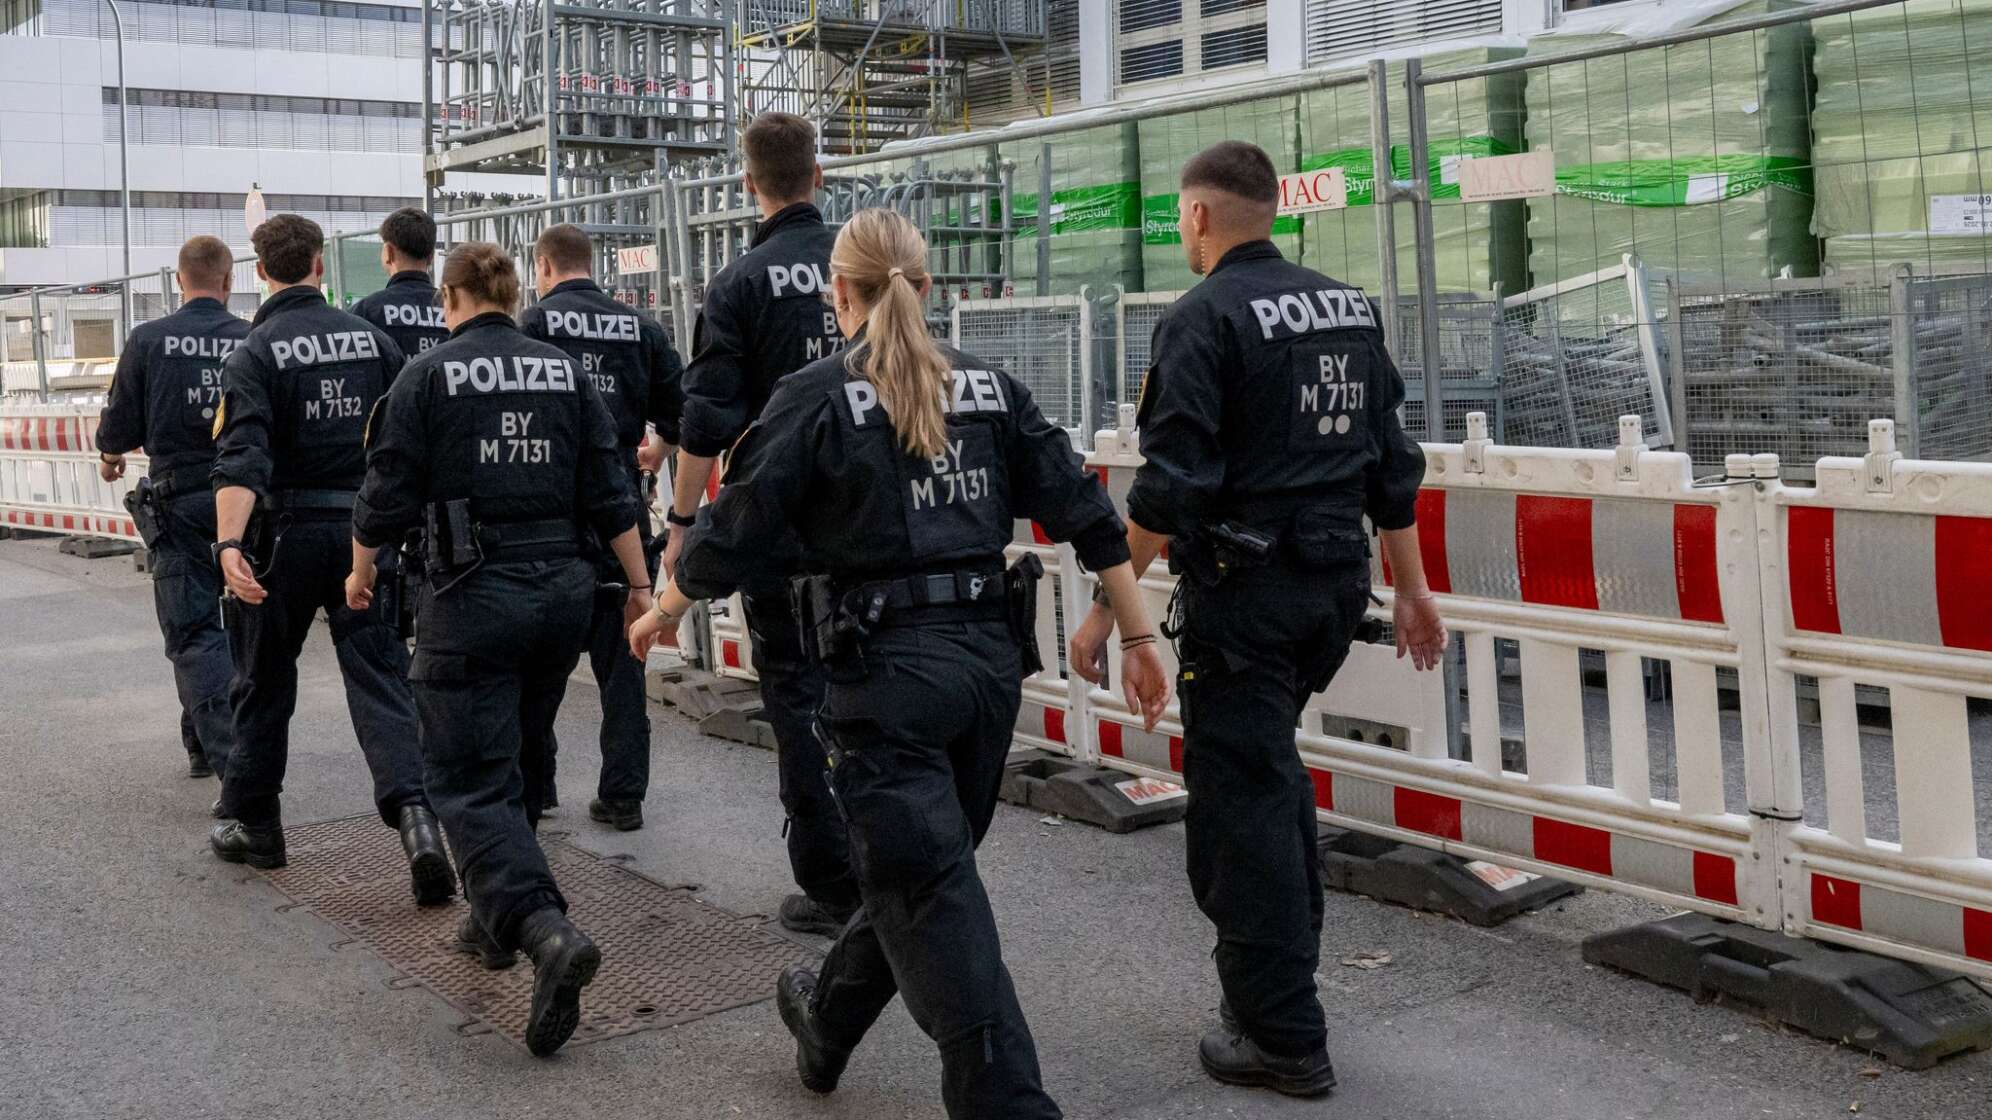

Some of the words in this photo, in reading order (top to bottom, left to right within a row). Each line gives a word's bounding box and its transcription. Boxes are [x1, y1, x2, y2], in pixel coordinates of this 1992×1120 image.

[620, 248, 650, 269] MAC
[384, 304, 448, 328] POLIZ
[545, 311, 641, 342] POLIZEI
[1251, 289, 1377, 339] POLIZEI
[165, 336, 243, 357] POLIZ
[271, 331, 379, 369] POLIZEI
[806, 337, 822, 360] M
[582, 352, 604, 372] BY
[1319, 355, 1348, 382] BY
[202, 368, 224, 386] BY
[444, 357, 575, 395] POLIZEI
[188, 387, 202, 405] M
[320, 378, 345, 400] BY
[844, 369, 1008, 426] PIZEI
[1301, 385, 1318, 412] M
[1327, 382, 1364, 409] 7131
[305, 401, 320, 420] M
[326, 397, 362, 418] 7132
[501, 412, 533, 437] BY
[480, 440, 499, 464] M
[507, 439, 550, 463] 7131
[931, 440, 964, 475] BY
[911, 477, 936, 510] M
[943, 467, 988, 504] 7131
